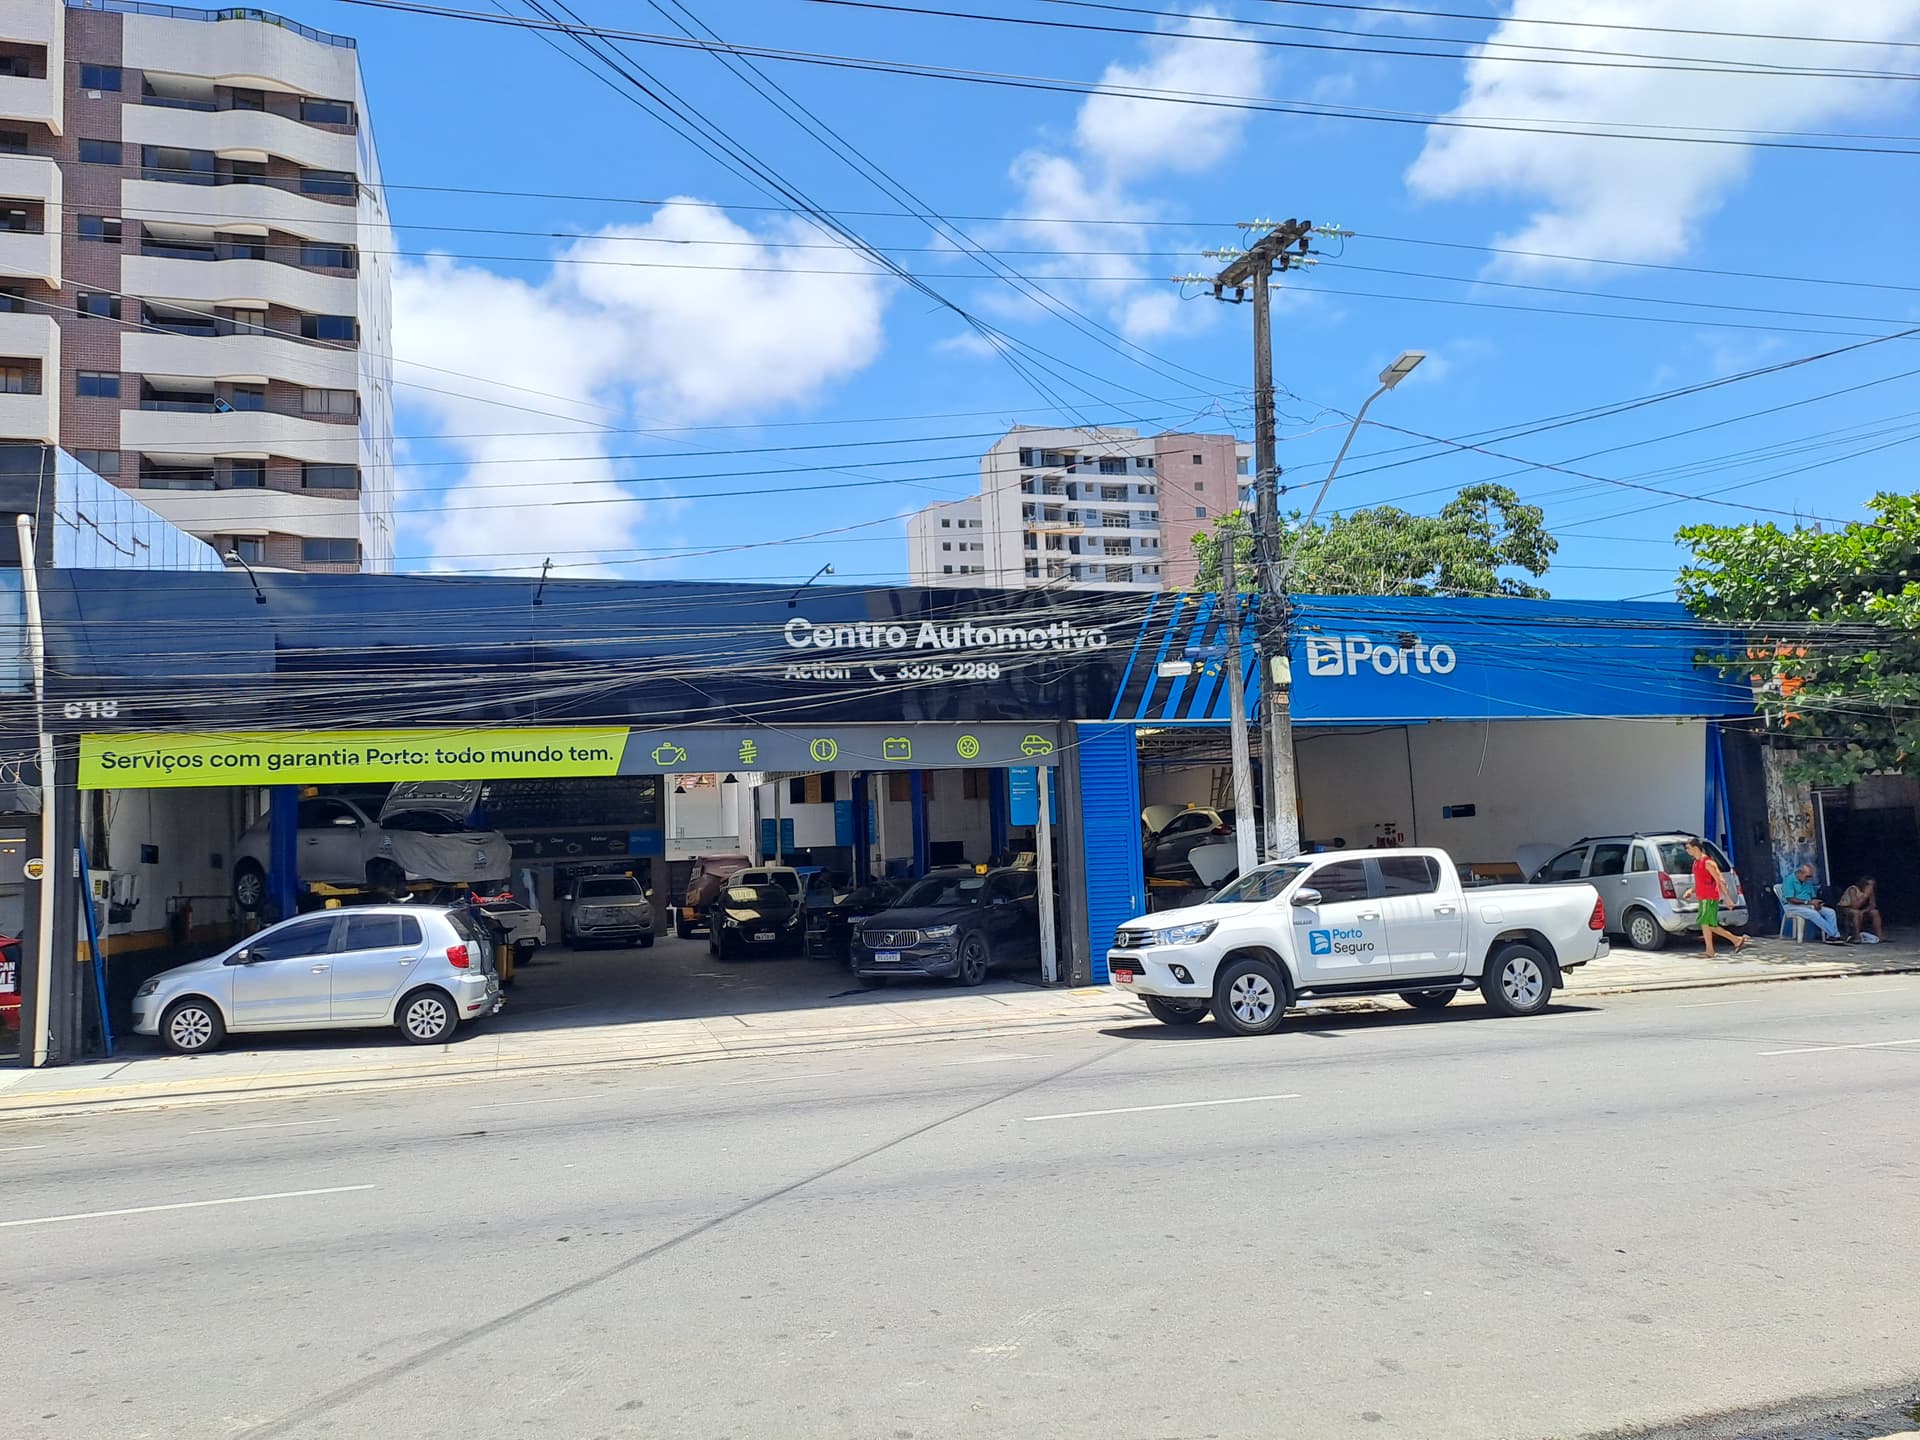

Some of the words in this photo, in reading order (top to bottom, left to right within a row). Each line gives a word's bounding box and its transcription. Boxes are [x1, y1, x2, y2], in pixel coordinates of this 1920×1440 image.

[784, 617, 907, 649] Centro
[915, 620, 1108, 649] Automotivo
[1345, 635, 1456, 676] Porto
[784, 661, 850, 680] Action
[896, 662, 1000, 680] 3325-2288
[101, 750, 204, 774] Serviços
[210, 753, 261, 769] com
[267, 748, 360, 771] garantia
[366, 748, 429, 765] Porto:
[435, 747, 485, 764] todo
[491, 746, 564, 763] mundo
[569, 747, 614, 761] tem.
[1332, 928, 1363, 940] Porto
[1334, 942, 1375, 955] Seguro
